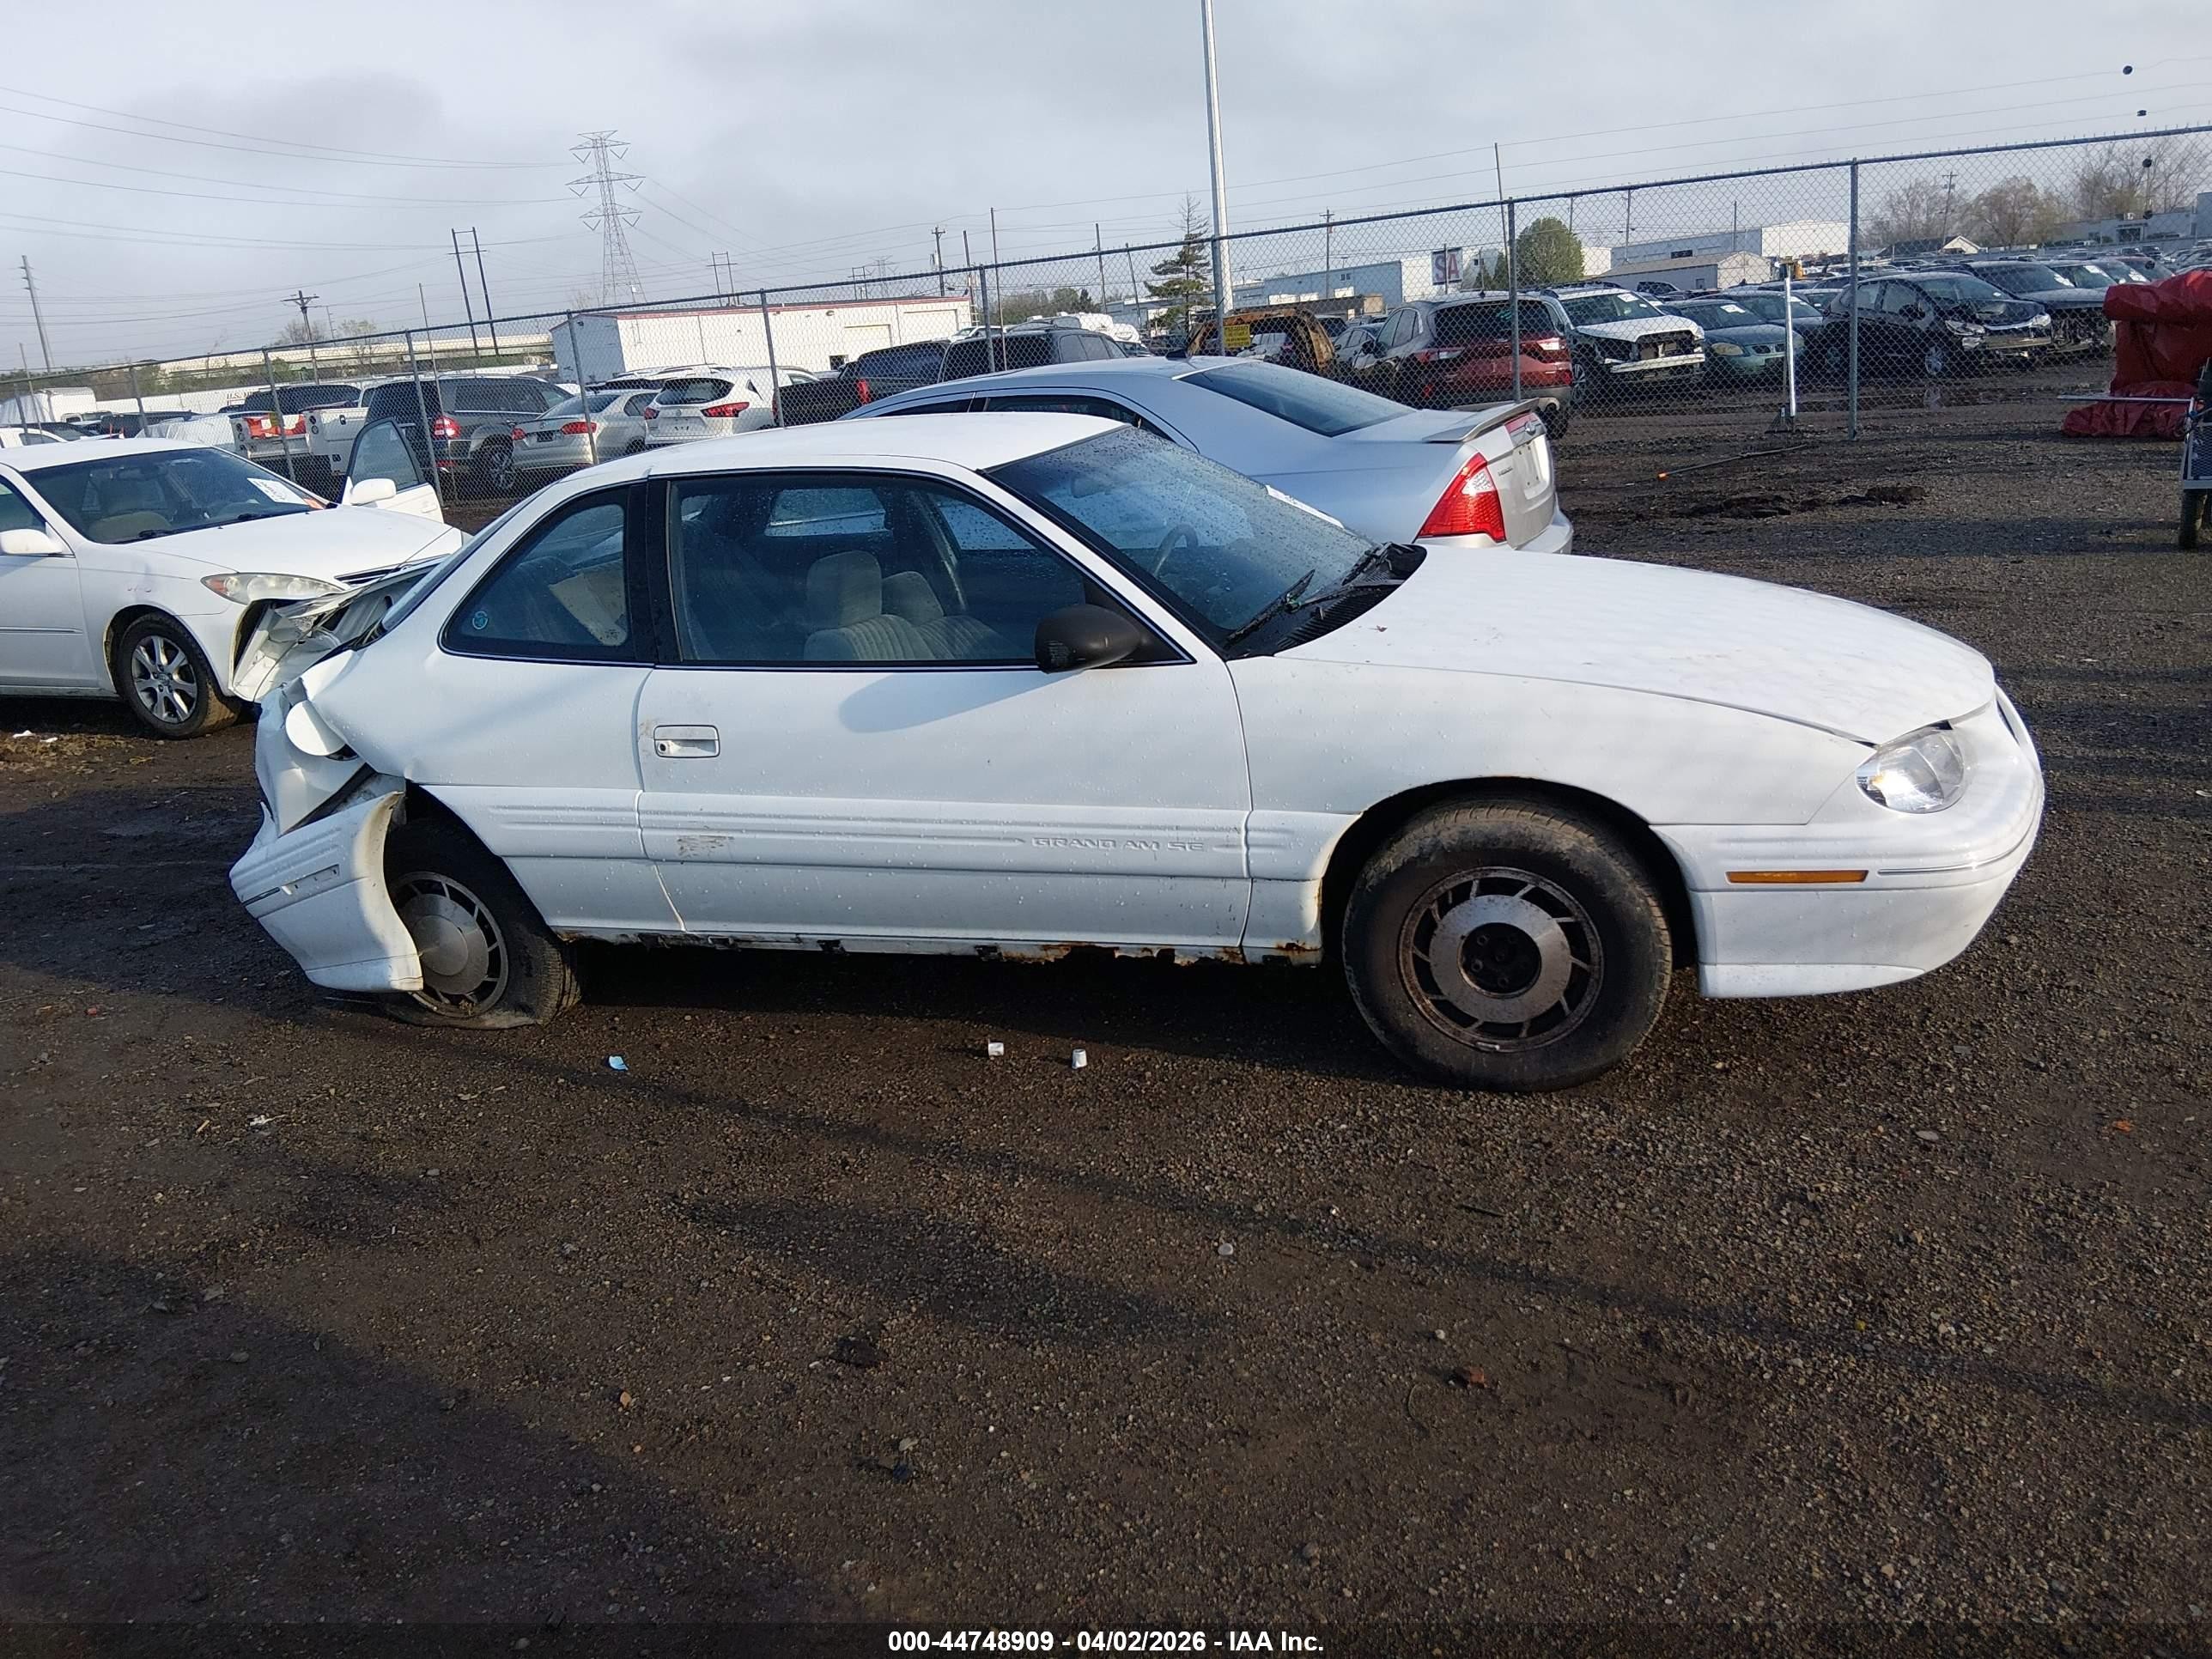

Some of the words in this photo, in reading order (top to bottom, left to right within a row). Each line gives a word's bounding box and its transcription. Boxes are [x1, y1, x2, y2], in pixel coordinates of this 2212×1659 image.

[1032, 837, 1116, 849] GRAND
[1123, 839, 1160, 850] AM
[1167, 842, 1203, 851] SE
